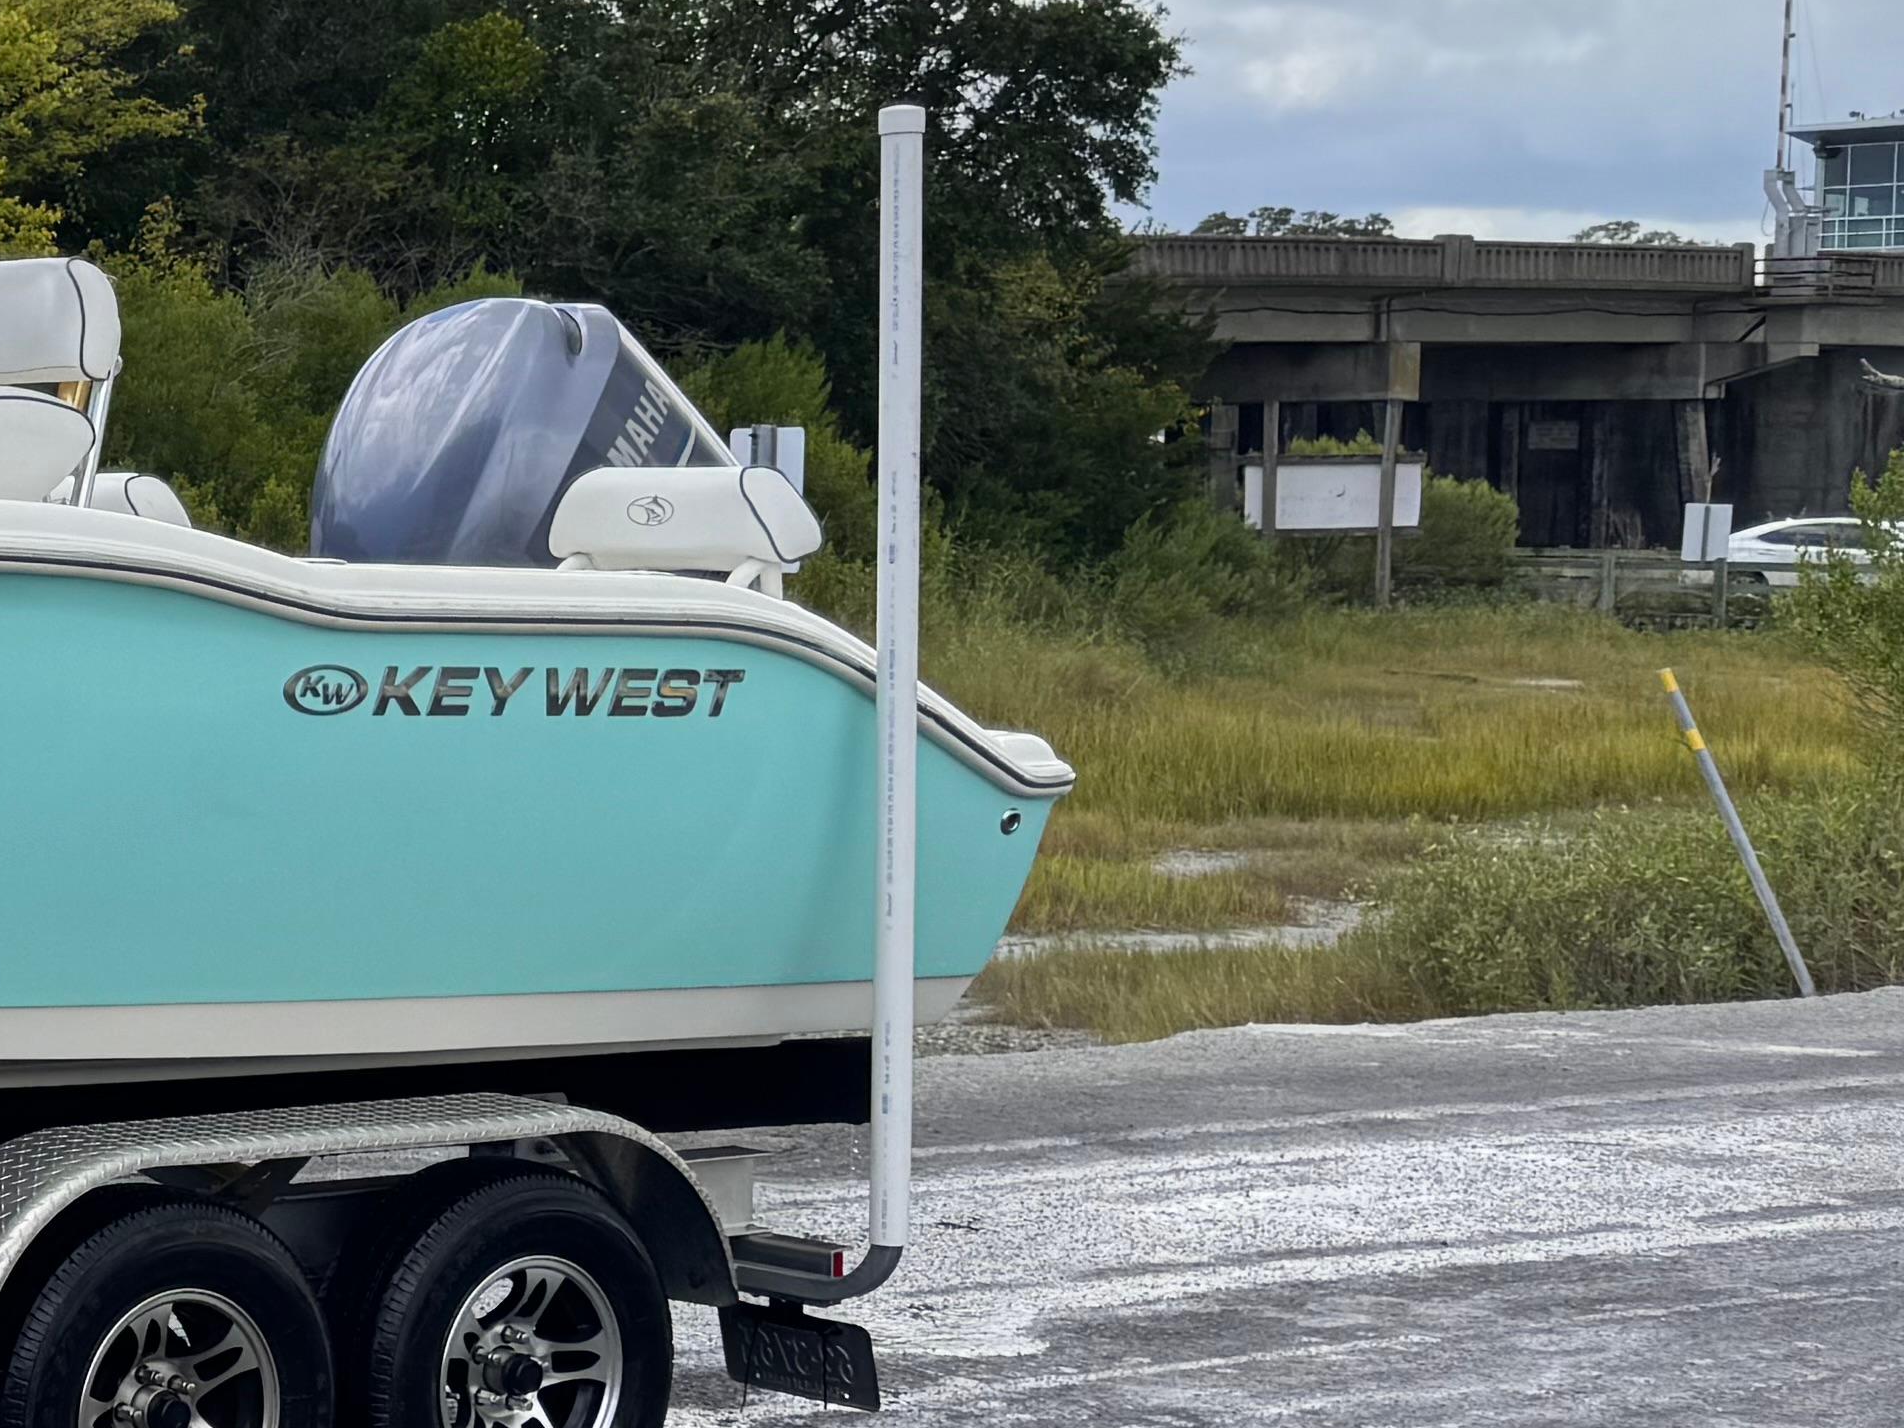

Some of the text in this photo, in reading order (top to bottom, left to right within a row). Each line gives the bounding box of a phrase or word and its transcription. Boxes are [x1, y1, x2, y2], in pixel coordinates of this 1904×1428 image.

[605, 378, 671, 468] MAHA
[372, 666, 746, 718] KEY WEST
